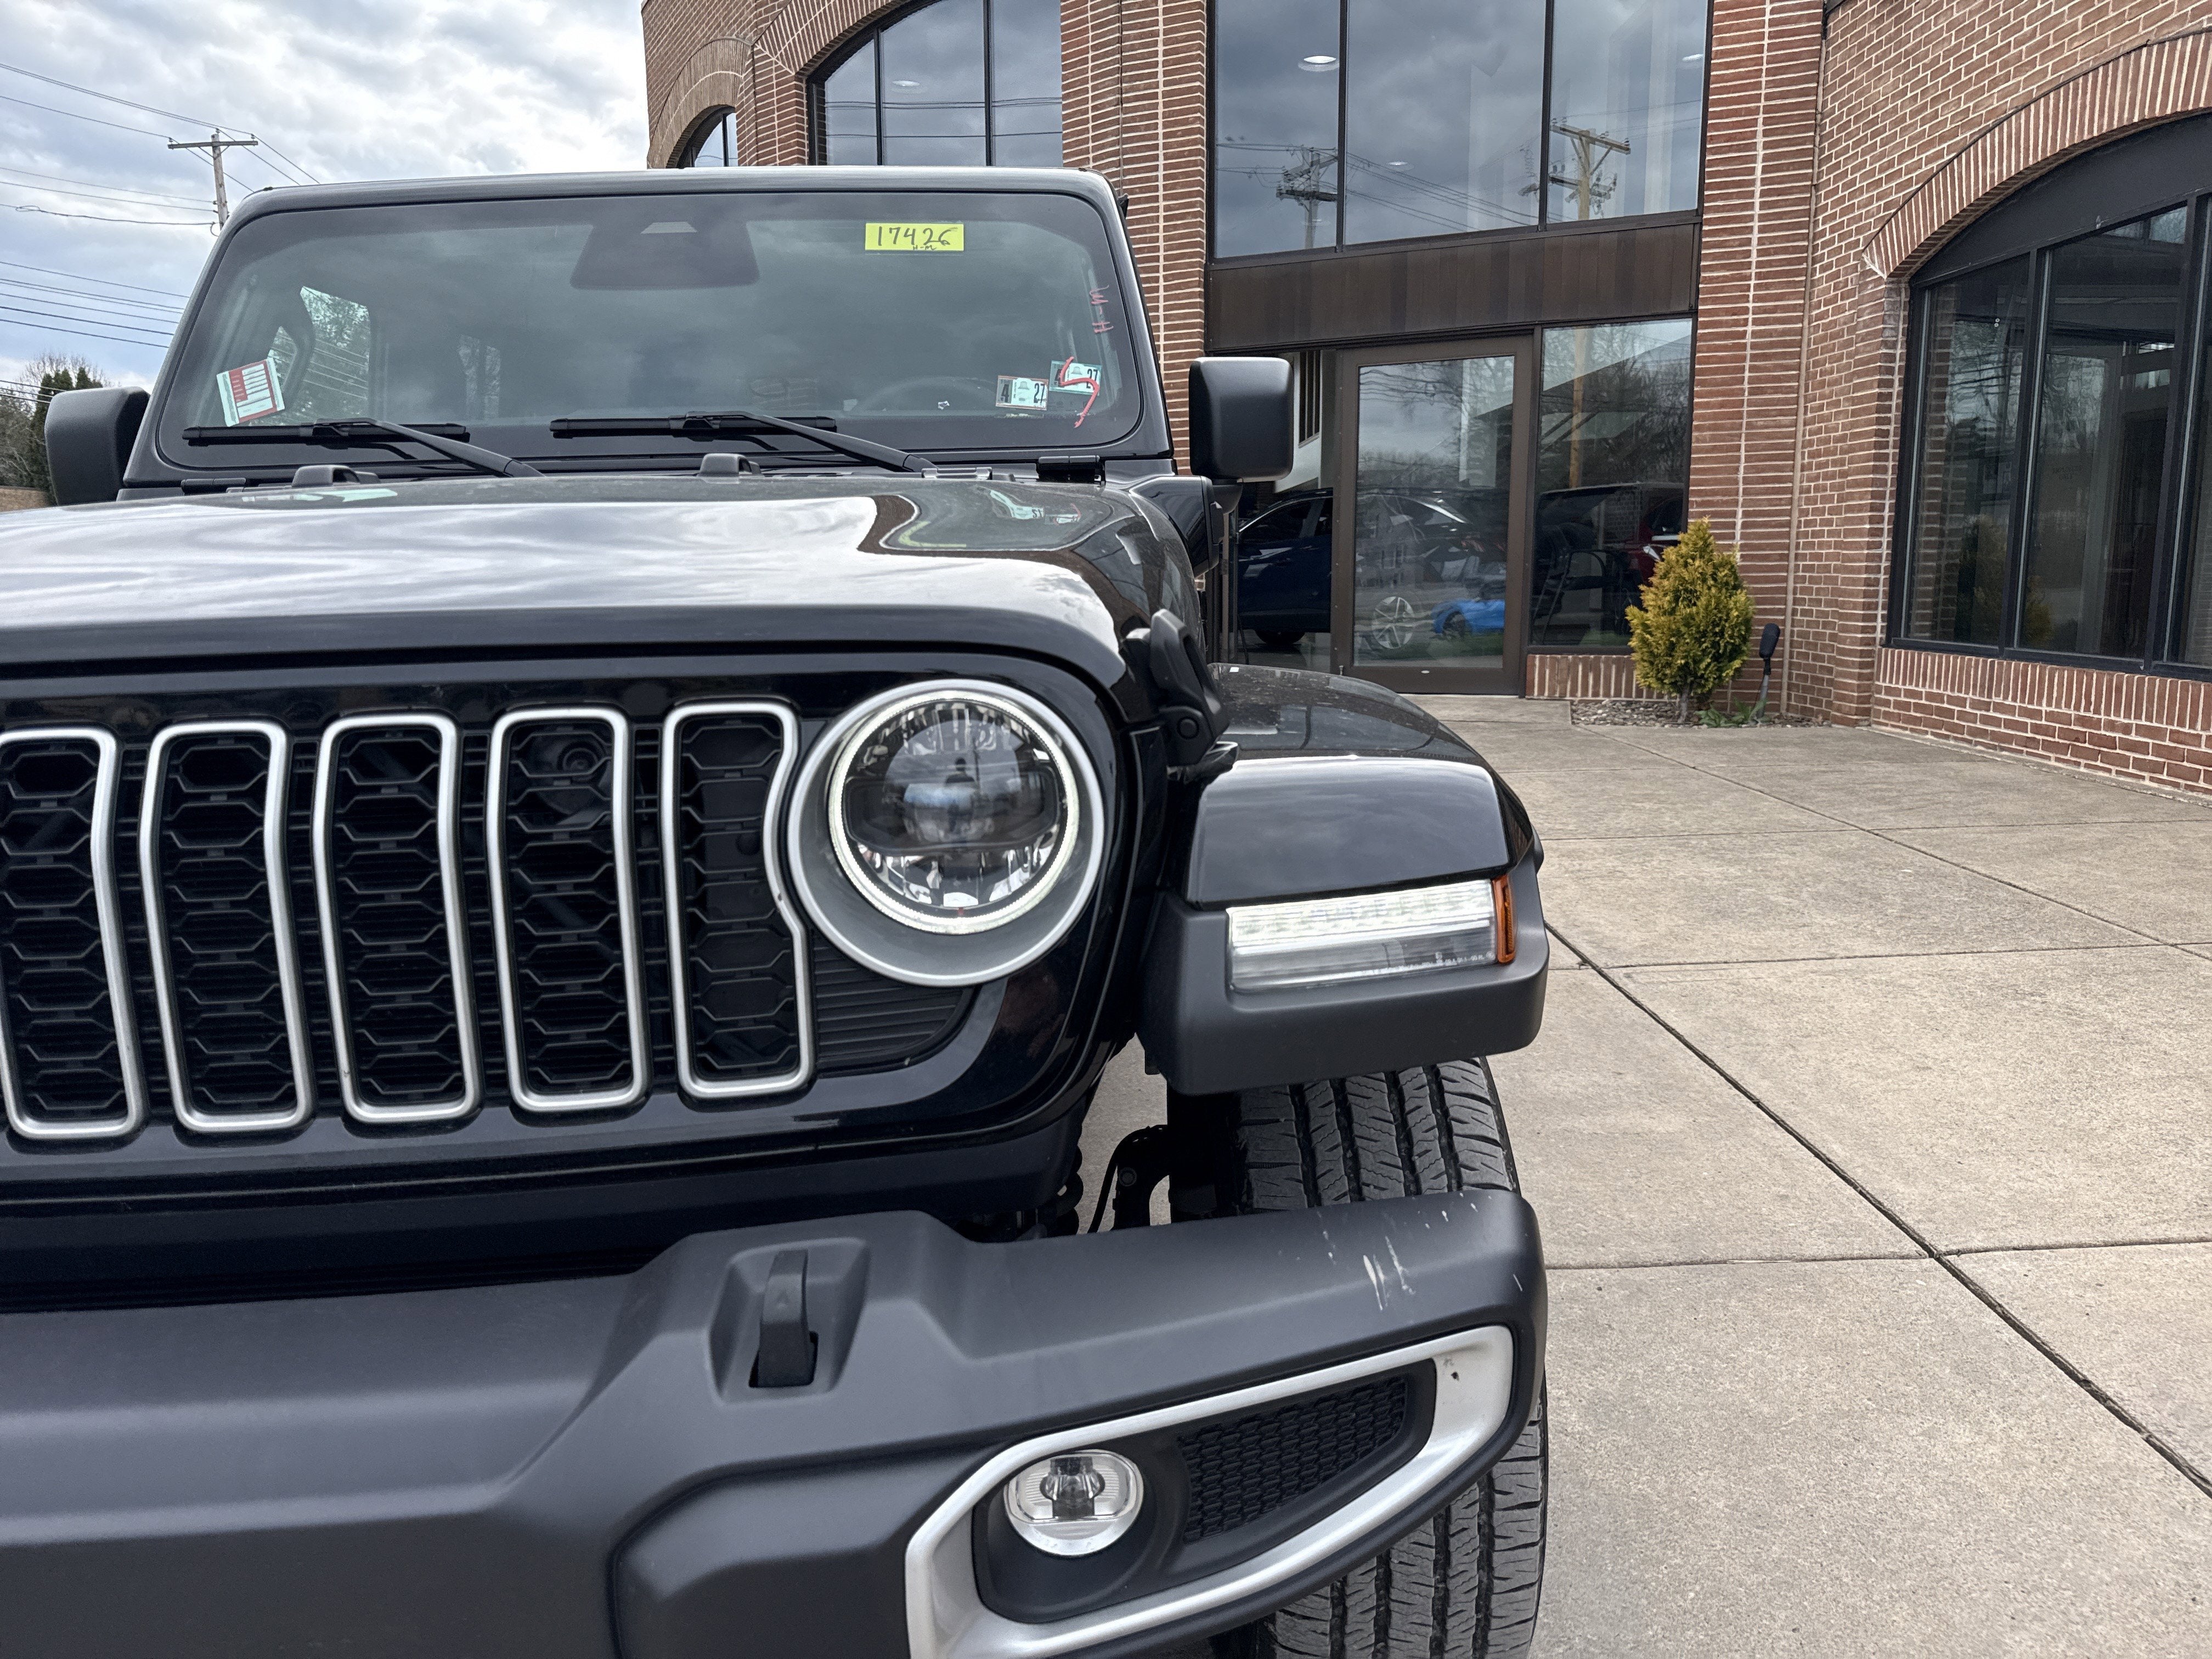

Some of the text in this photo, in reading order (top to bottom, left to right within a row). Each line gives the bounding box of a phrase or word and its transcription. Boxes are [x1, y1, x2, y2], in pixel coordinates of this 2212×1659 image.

[878, 225, 957, 246] 17426
[1001, 384, 1009, 403] 4
[1033, 382, 1045, 403] 27
